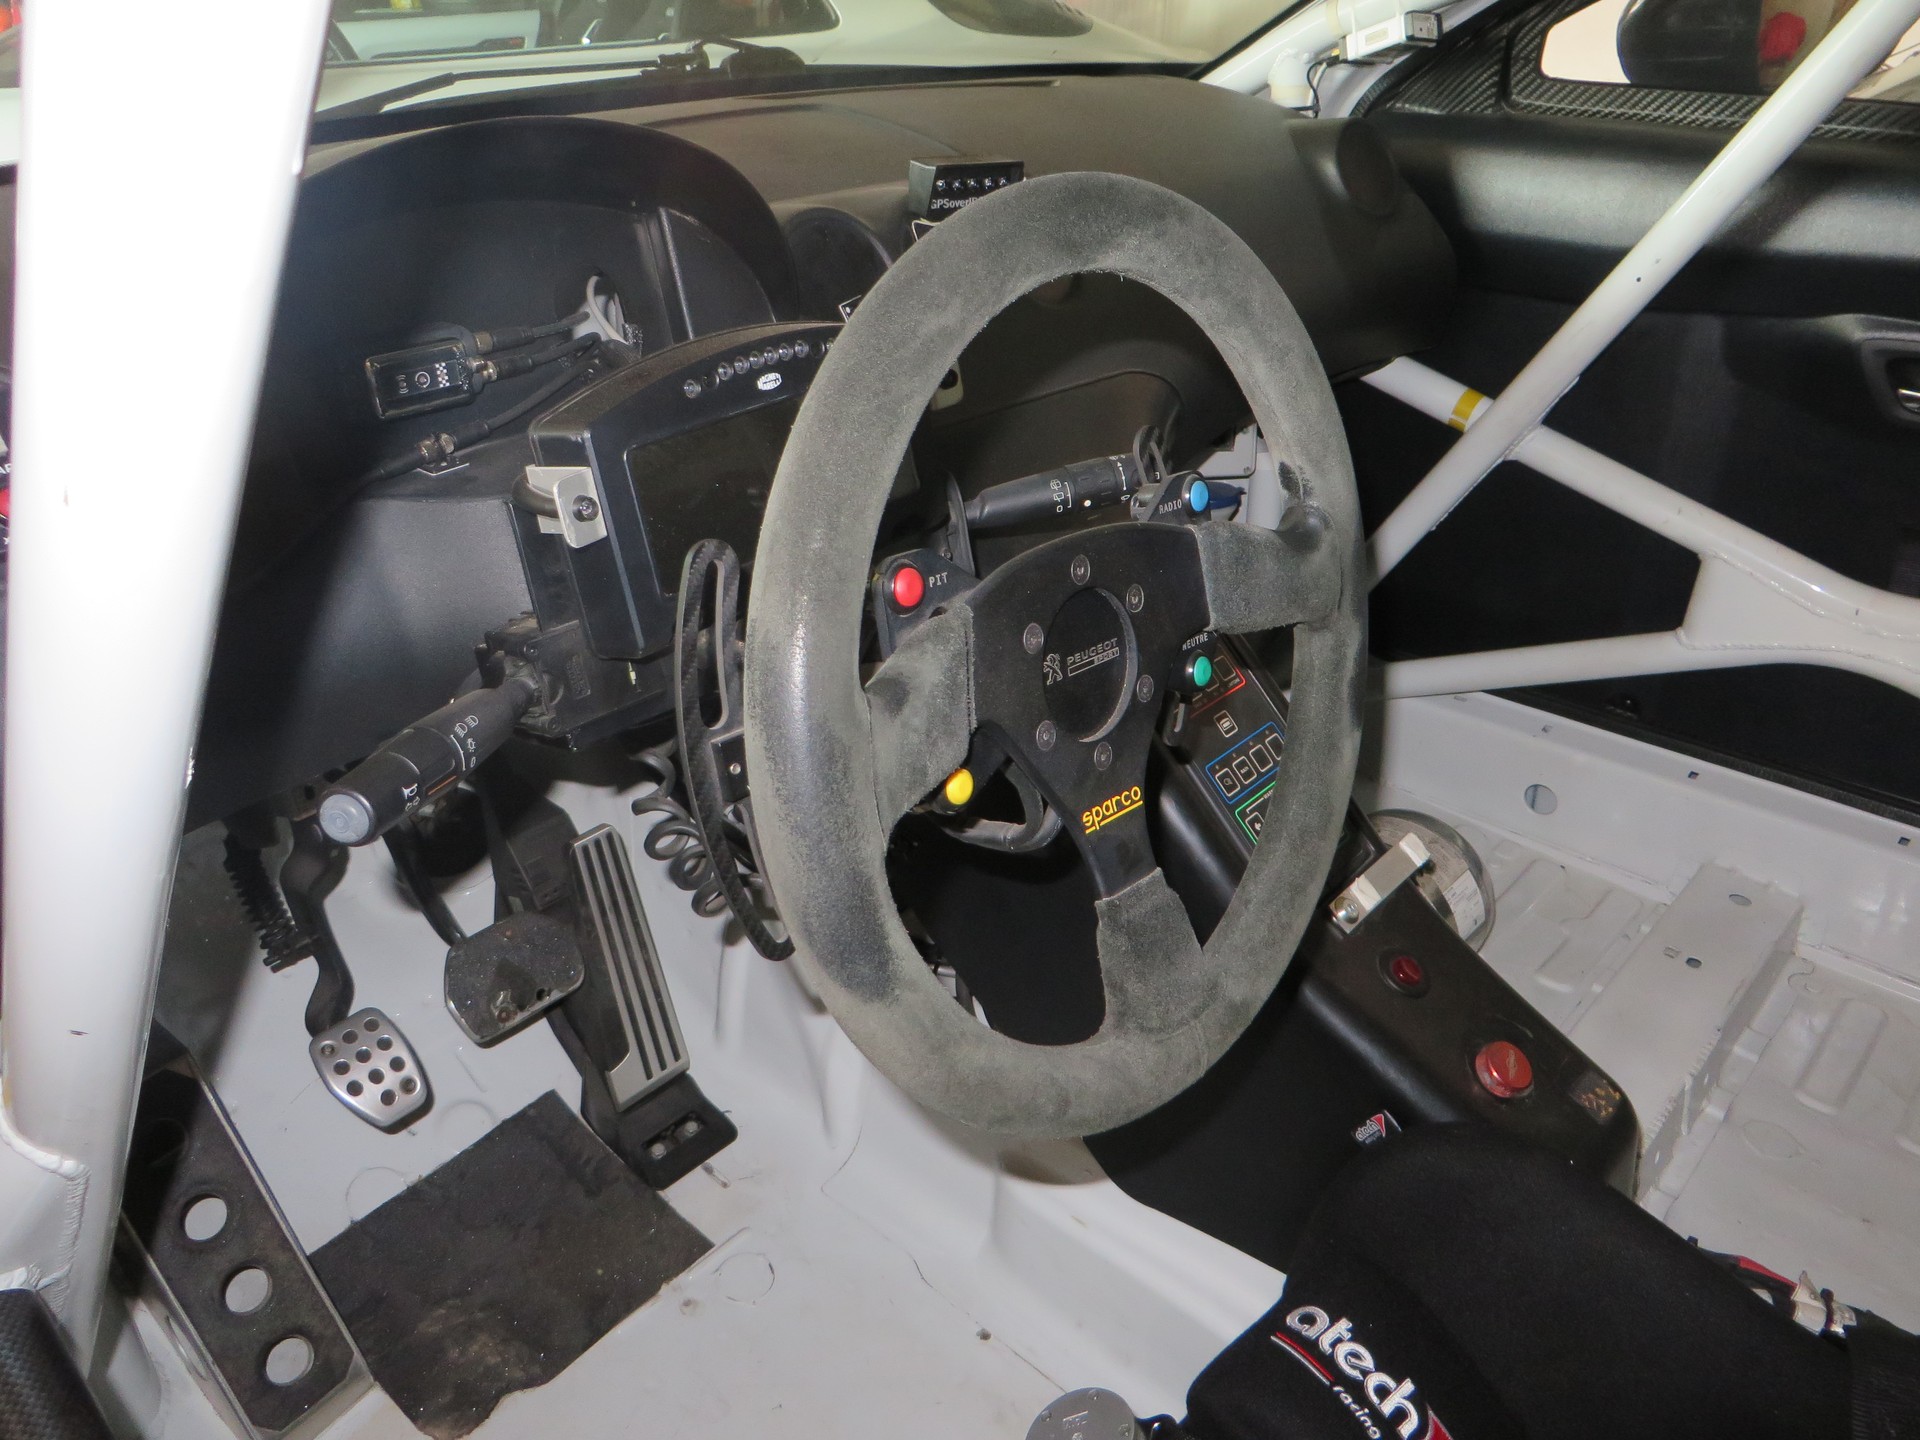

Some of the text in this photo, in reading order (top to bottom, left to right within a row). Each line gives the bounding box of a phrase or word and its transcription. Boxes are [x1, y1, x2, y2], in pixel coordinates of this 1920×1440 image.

[1159, 499, 1182, 514] RADIO
[929, 572, 948, 588] PIT
[1066, 638, 1118, 666] PEUGEOT
[1182, 632, 1208, 651] NEUTRE
[1082, 786, 1142, 831] sparco
[1286, 1306, 1419, 1440] atech
[1332, 1386, 1382, 1440] racing
